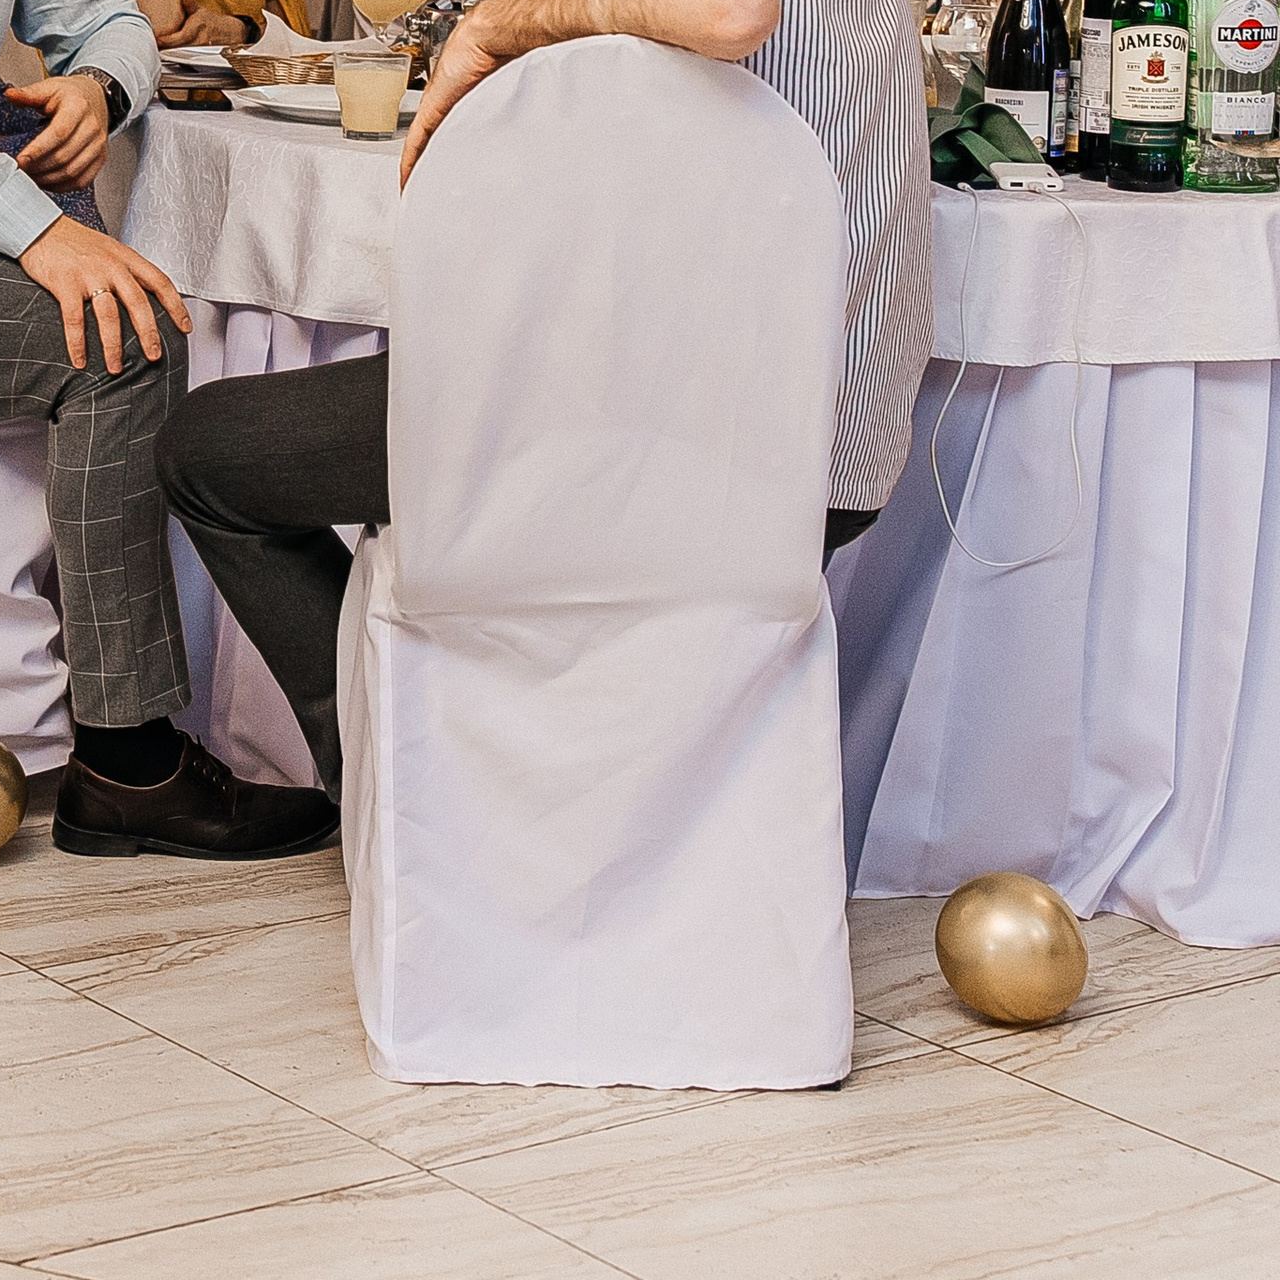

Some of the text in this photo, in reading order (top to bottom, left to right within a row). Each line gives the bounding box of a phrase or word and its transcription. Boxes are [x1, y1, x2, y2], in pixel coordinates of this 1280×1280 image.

[1220, 27, 1276, 41] MARTINI
[1118, 33, 1187, 53] JAMESON
[995, 98, 1024, 106] MARCHESINI
[1226, 96, 1267, 104] BIANCO
